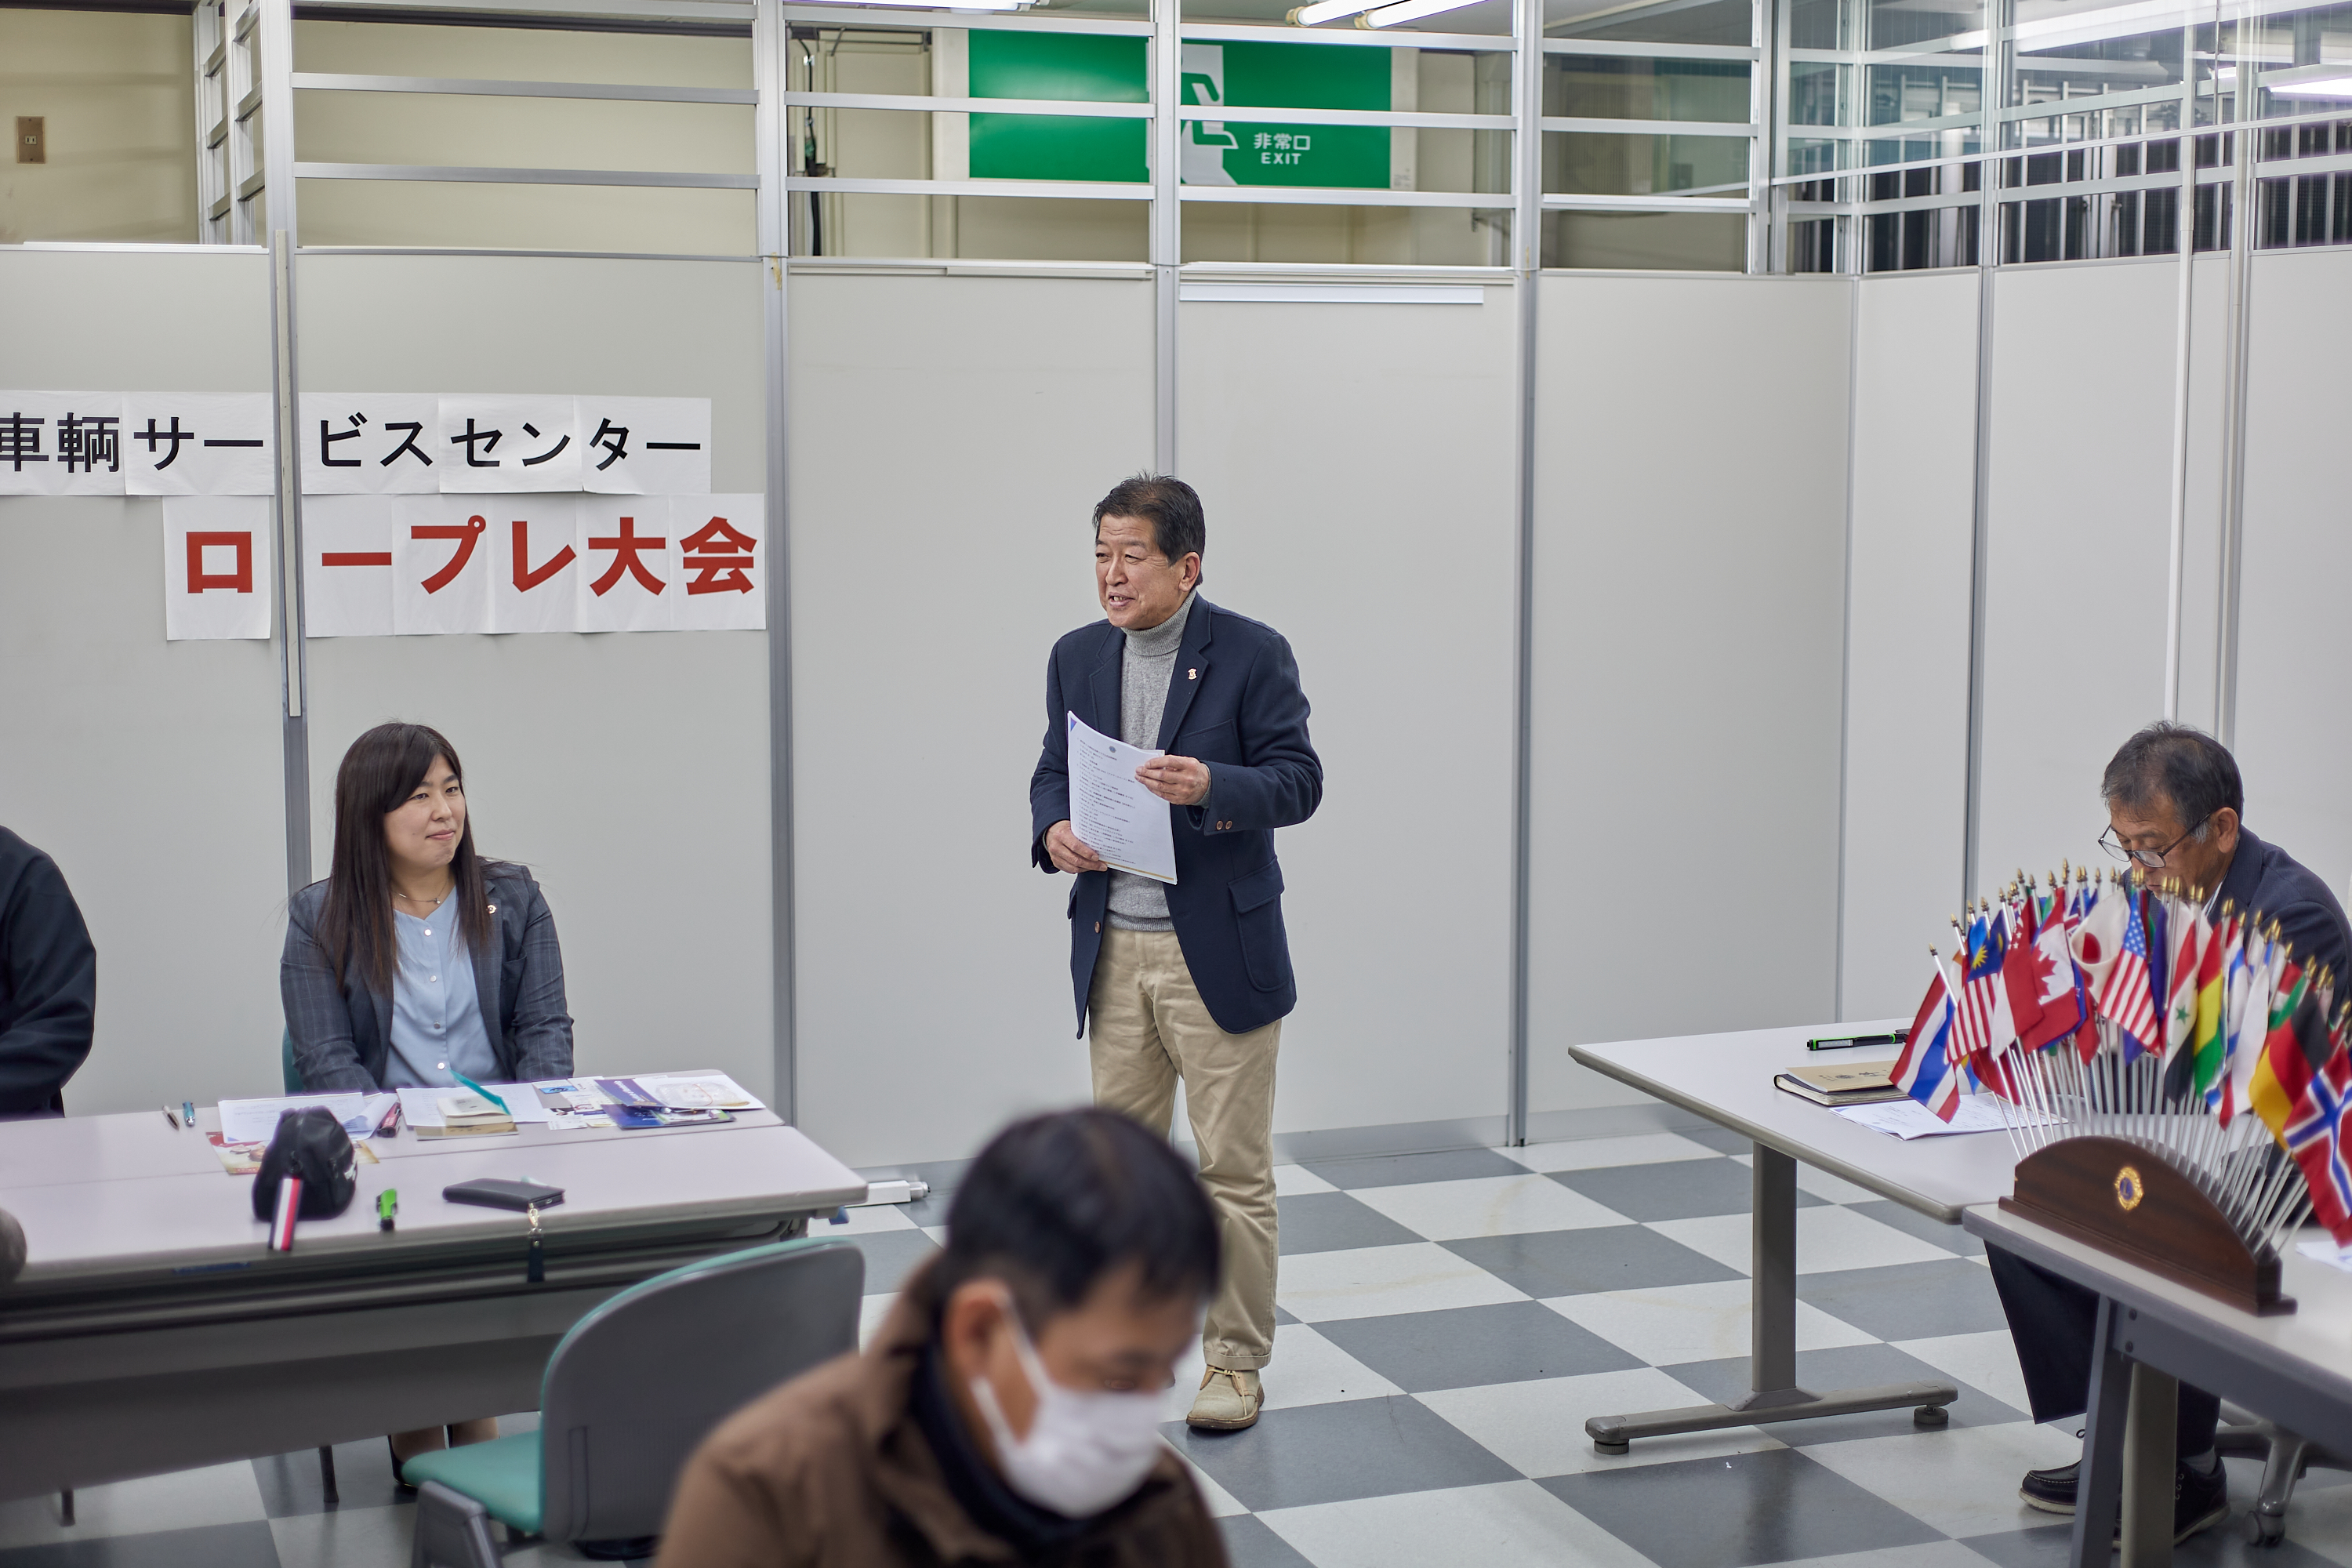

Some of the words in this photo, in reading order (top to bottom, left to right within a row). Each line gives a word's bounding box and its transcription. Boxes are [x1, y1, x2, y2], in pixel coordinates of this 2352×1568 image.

[1254, 132, 1311, 151] 非常口
[1261, 151, 1301, 165] EXIT
[186, 514, 757, 596] ロープレ大会
